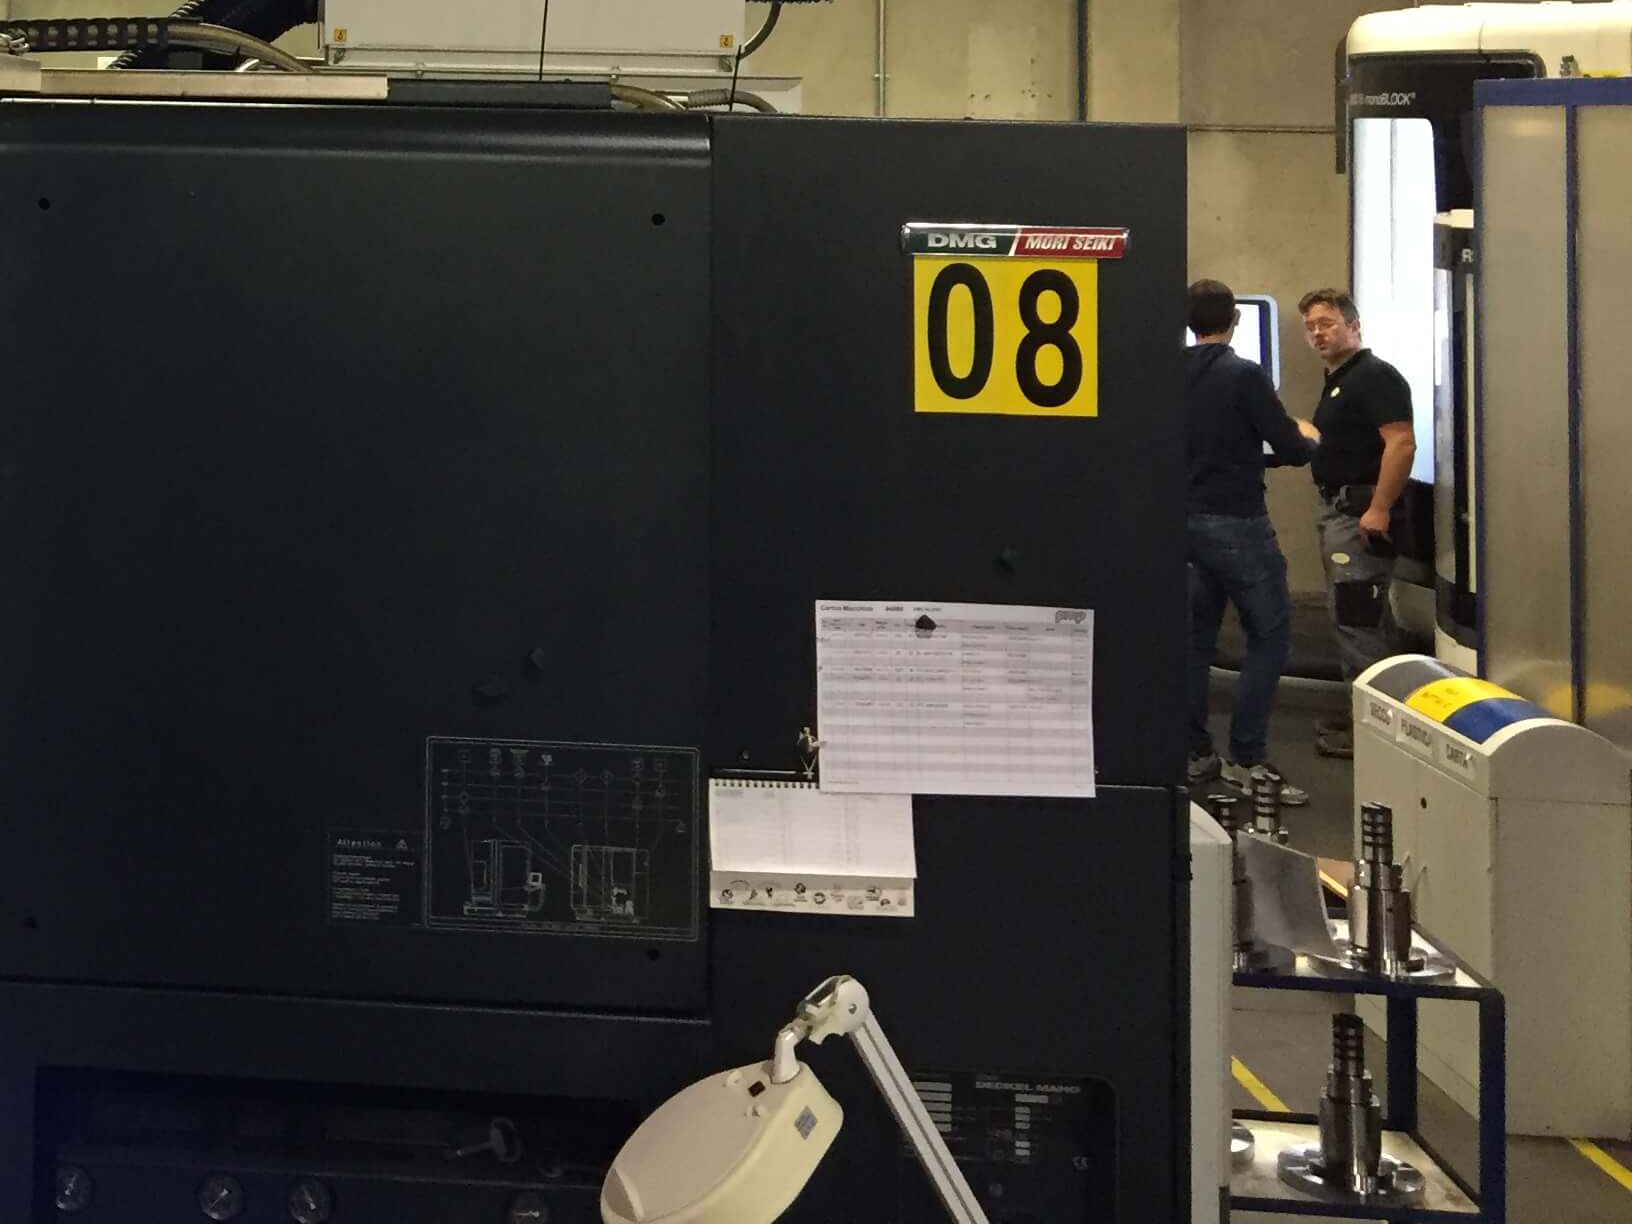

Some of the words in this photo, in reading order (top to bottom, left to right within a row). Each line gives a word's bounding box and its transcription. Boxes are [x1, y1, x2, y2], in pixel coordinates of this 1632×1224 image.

[927, 232, 997, 249] DMG
[1024, 235, 1068, 251] MORI
[1071, 236, 1117, 252] SEIKI
[926, 262, 1084, 408] 08
